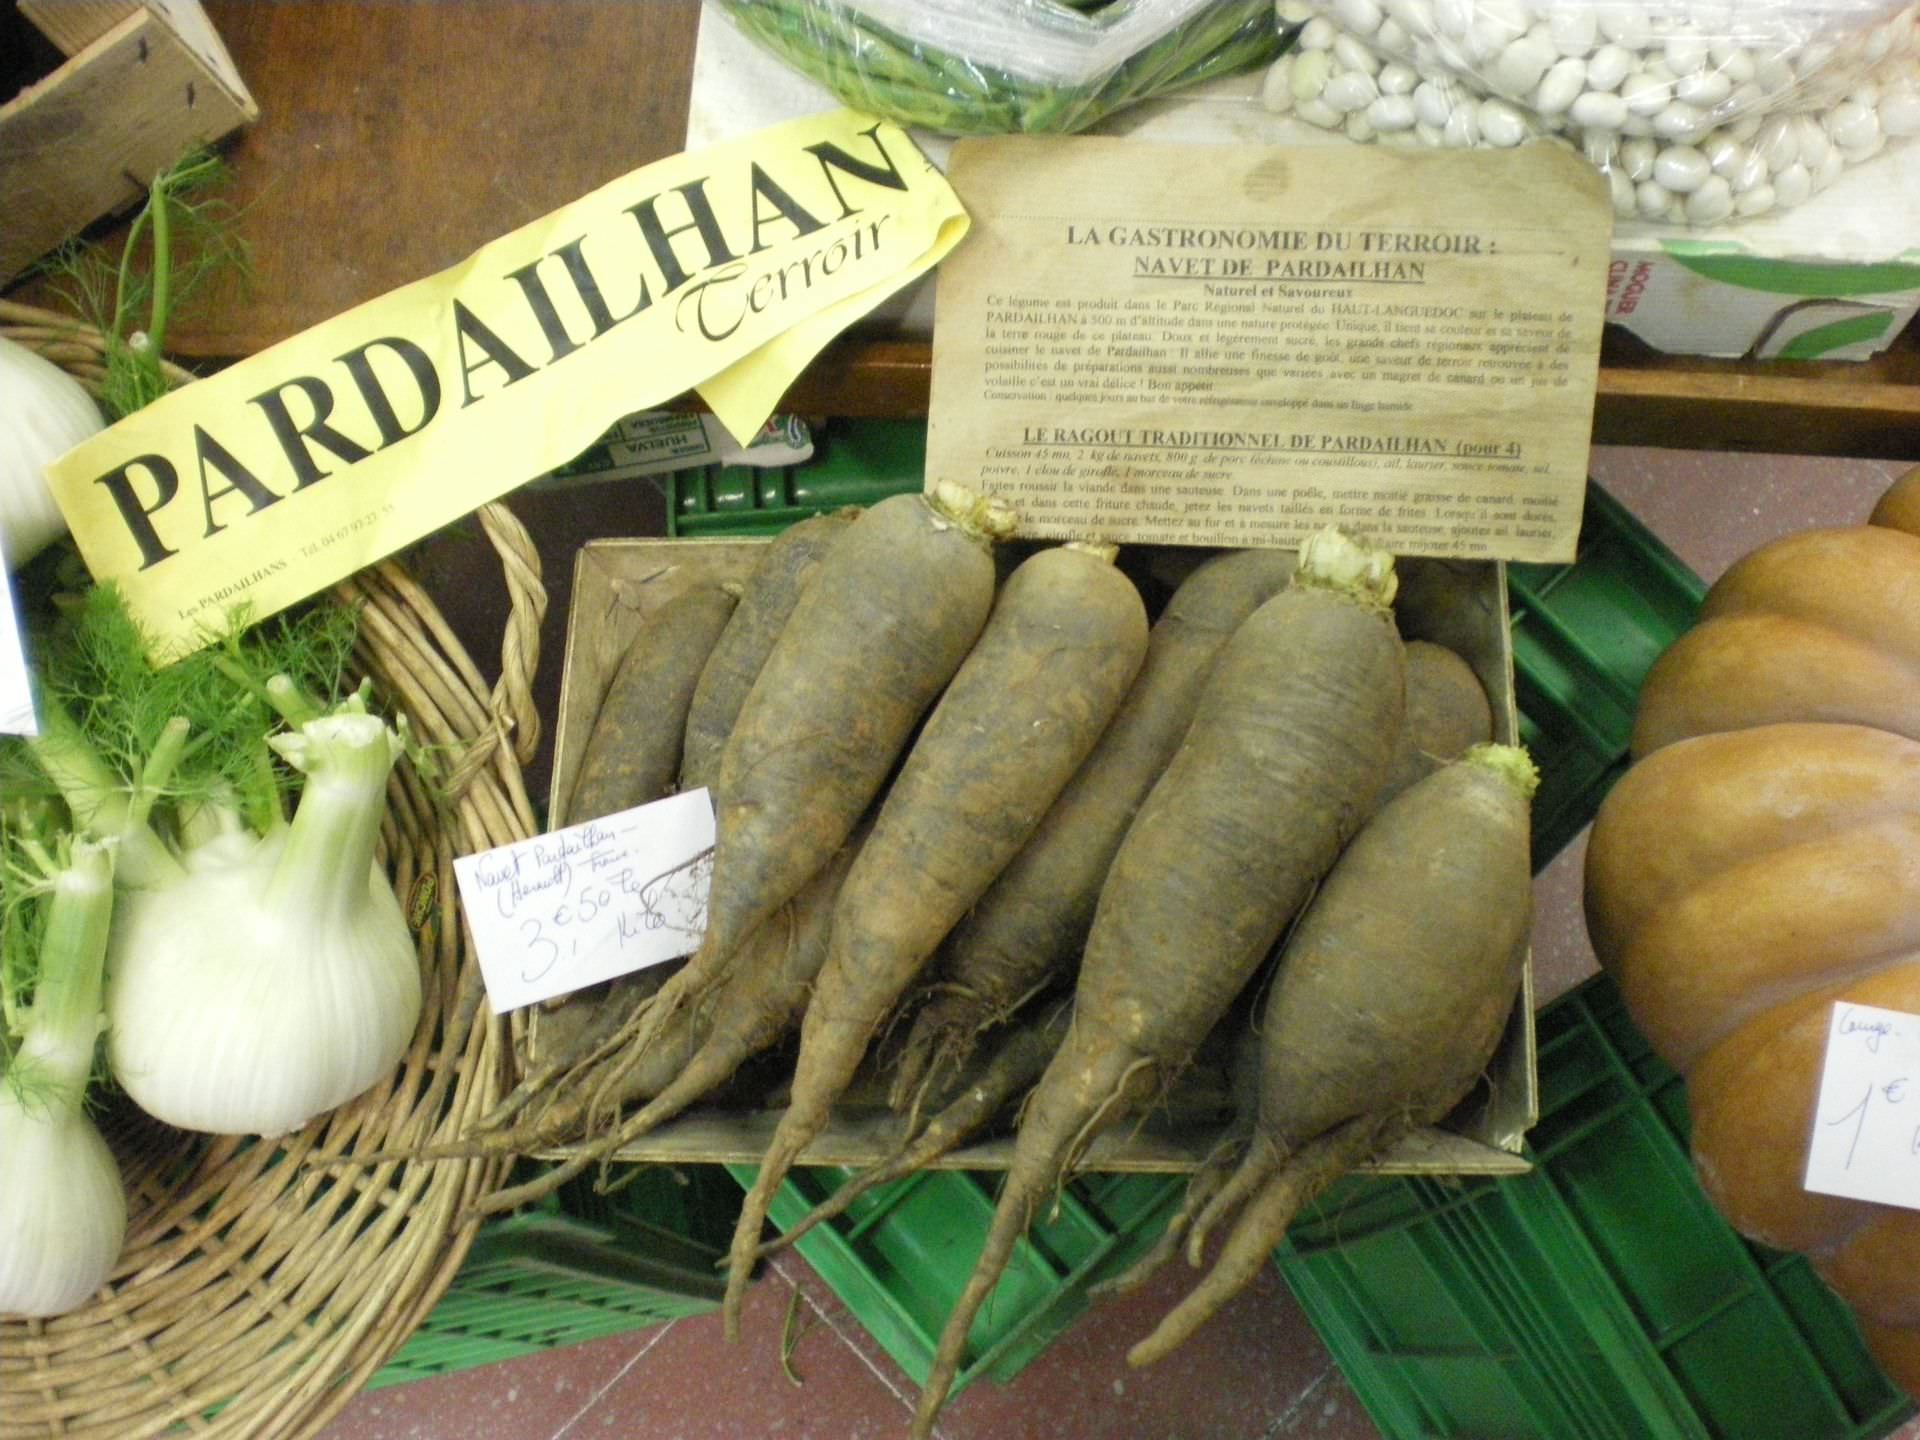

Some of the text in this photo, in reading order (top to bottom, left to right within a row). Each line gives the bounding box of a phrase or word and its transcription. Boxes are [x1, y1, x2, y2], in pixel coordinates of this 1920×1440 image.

[1067, 225, 1101, 246] LA
[1109, 226, 1308, 250] GASTRONOMIE
[1316, 231, 1350, 251] DU
[1359, 231, 1481, 255] TERROIR
[674, 210, 893, 344] Terroir
[1134, 256, 1425, 280] NAVET DE PARDAILHAN
[1203, 283, 1353, 299] Naturel et Savoureux
[1055, 296, 1072, 308] est
[1077, 296, 1118, 312] produit
[1124, 298, 1151, 310] dans
[1172, 299, 1199, 311] Parc
[1262, 301, 1305, 313] Naturel
[986, 311, 1078, 325] PARDAILHAN
[1188, 316, 1214, 328] dans
[1216, 320, 1237, 328] une
[1240, 317, 1276, 329] nature
[94, 123, 911, 573] PARDAILHAN
[1002, 327, 1029, 339] terre
[1034, 331, 1066, 342] rouge
[1162, 331, 1192, 343] Doux
[1325, 335, 1340, 346] les
[1346, 335, 1384, 350] grands
[1390, 336, 1421, 349] chefs
[984, 343, 1029, 355] cuisiner
[1050, 344, 1082, 356] navet
[1107, 345, 1168, 358] Pardailhan
[1224, 352, 1246, 361] une
[1251, 349, 1290, 362] finesse
[984, 374, 1025, 386] volaille
[1078, 376, 1099, 388] vrai
[1148, 378, 1172, 390] Bon
[1183, 364, 1250, 377] nombreuses
[1256, 369, 1277, 380] que
[1330, 371, 1356, 380] avec
[1382, 369, 1421, 385] magret
[625, 434, 688, 454] HUELVA
[1024, 427, 1522, 457] LE RAGOUT TRADITIONNEL DE PARDAILHAN (pour 4)
[985, 446, 1032, 459] Cuisson
[1219, 455, 1246, 467] porc
[1134, 469, 1183, 479] morceau
[1078, 481, 1116, 493] viande
[1120, 482, 1146, 494] dans
[1150, 486, 1171, 495] une
[1232, 485, 1262, 497] Dans
[1266, 489, 1287, 498] une
[1332, 488, 1369, 500] mettre
[1031, 495, 1057, 507] dans
[1063, 496, 1090, 508] cette
[1096, 497, 1130, 509] friture
[1184, 499, 1211, 514] jetez
[1216, 500, 1233, 512] les
[1238, 501, 1274, 513] navets
[1338, 504, 1372, 516] forme
[1145, 515, 1183, 527] Mettez
[1294, 519, 1310, 530] les
[198, 558, 288, 611] PARDAILHANS
